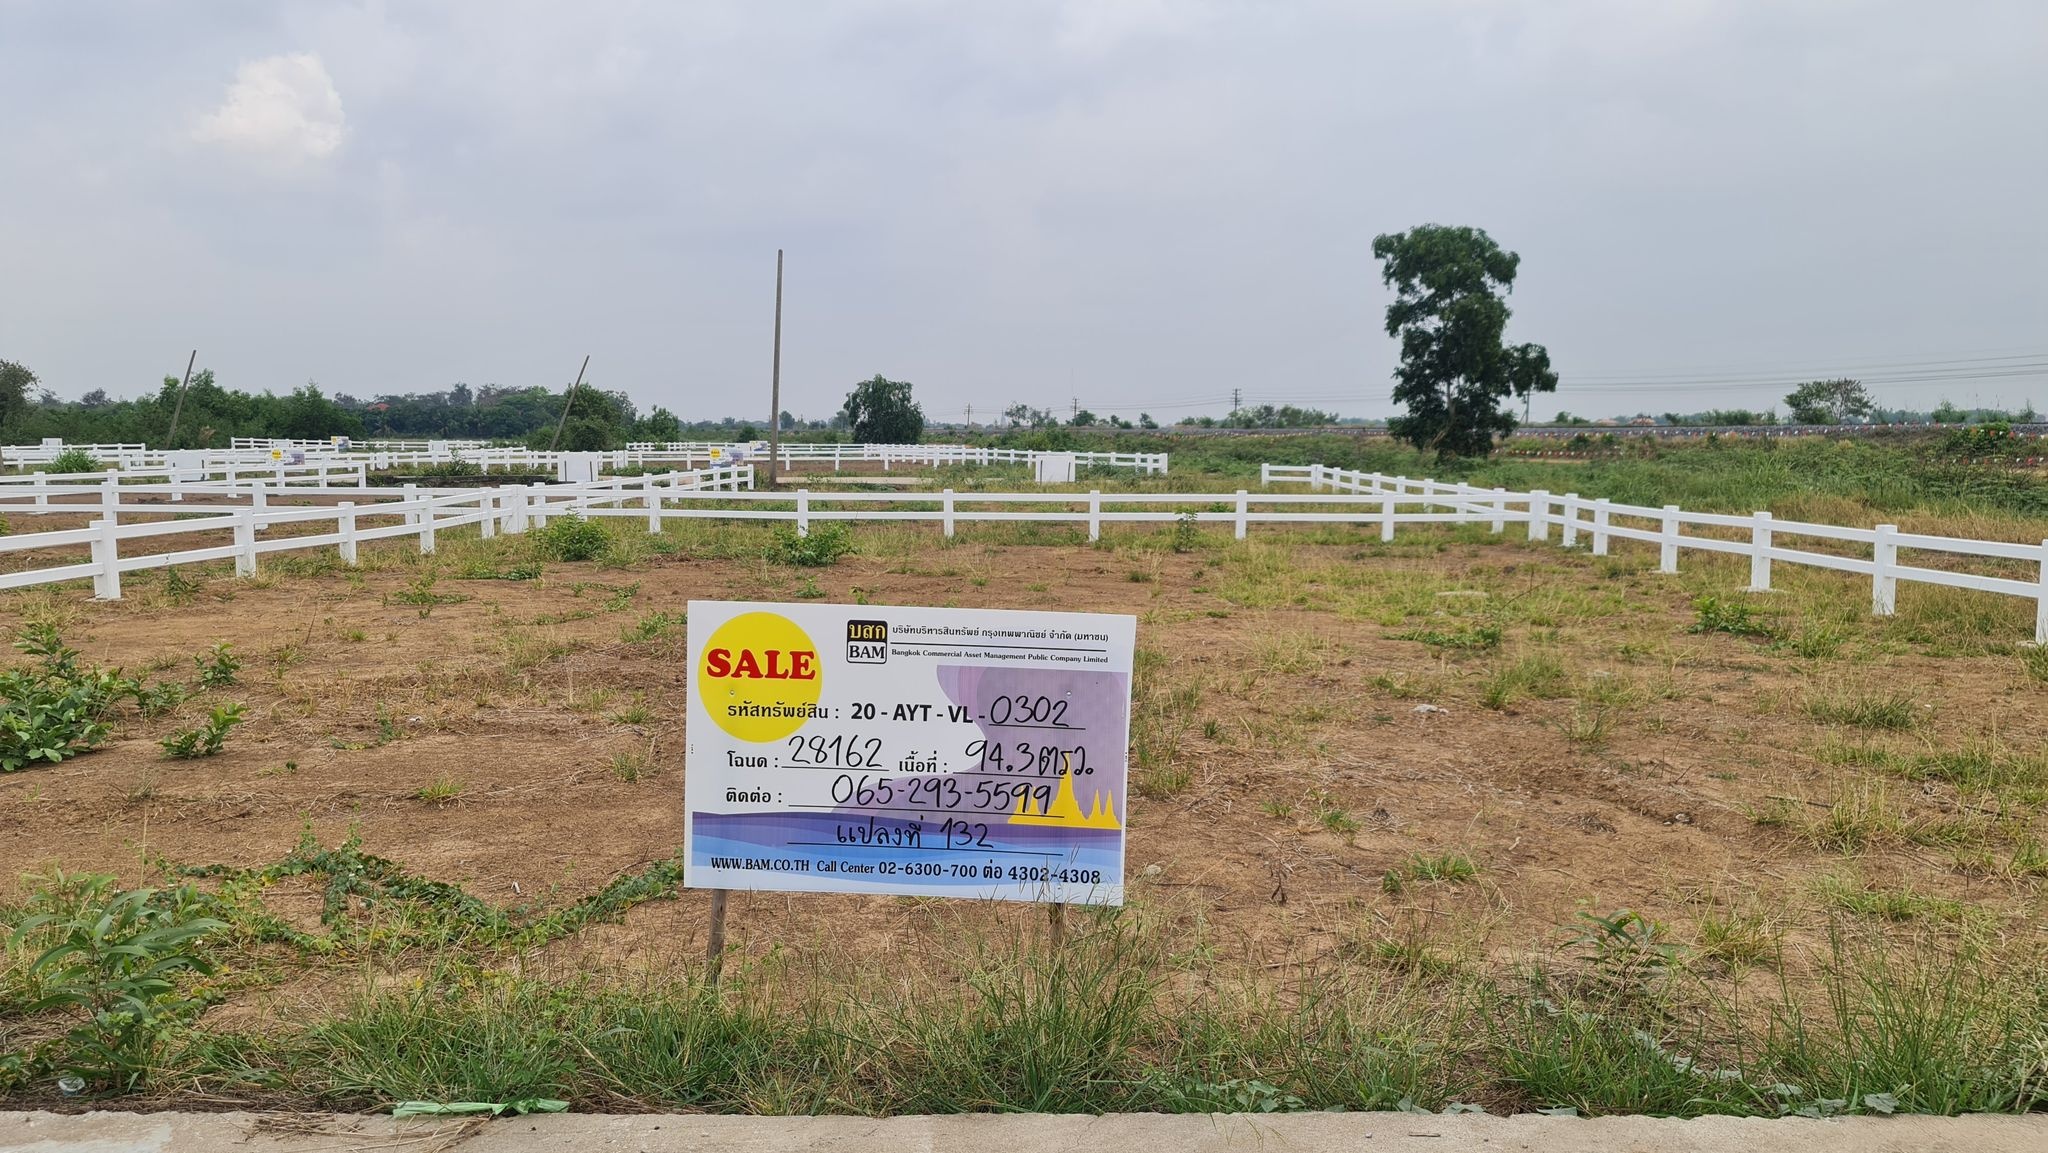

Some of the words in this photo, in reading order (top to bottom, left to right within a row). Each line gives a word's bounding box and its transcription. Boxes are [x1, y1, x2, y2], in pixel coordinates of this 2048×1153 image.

[849, 623, 886, 639] บสก
[892, 625, 979, 637] บริษัทบริหารสินทรัพย์
[1049, 630, 1071, 640] จำกัด
[1074, 633, 1108, 642] (มหาชน)
[707, 648, 815, 680] SALE
[849, 645, 885, 659] BAM
[984, 652, 1026, 661] Management
[1050, 655, 1081, 663] Company
[728, 701, 828, 719] รหัสทรัพย์สิน
[851, 703, 875, 720] 20
[893, 704, 932, 721] AYT
[948, 706, 973, 723] VL
[727, 750, 768, 768] โฉนด
[788, 735, 882, 768] 28162
[899, 751, 937, 773] เนื้อที่
[726, 787, 771, 803] ติดต่อ
[831, 774, 1051, 815] 065-293-5599
[837, 815, 922, 848] แปลงที่
[939, 817, 994, 849] 132
[711, 857, 809, 871] WWW.BAM.CO.TH
[817, 861, 837, 872] Call
[841, 863, 875, 874] Center
[878, 862, 978, 878] 02-6300-700
[983, 859, 1003, 879] ต่อ
[1008, 866, 1101, 884] 4302-4308
